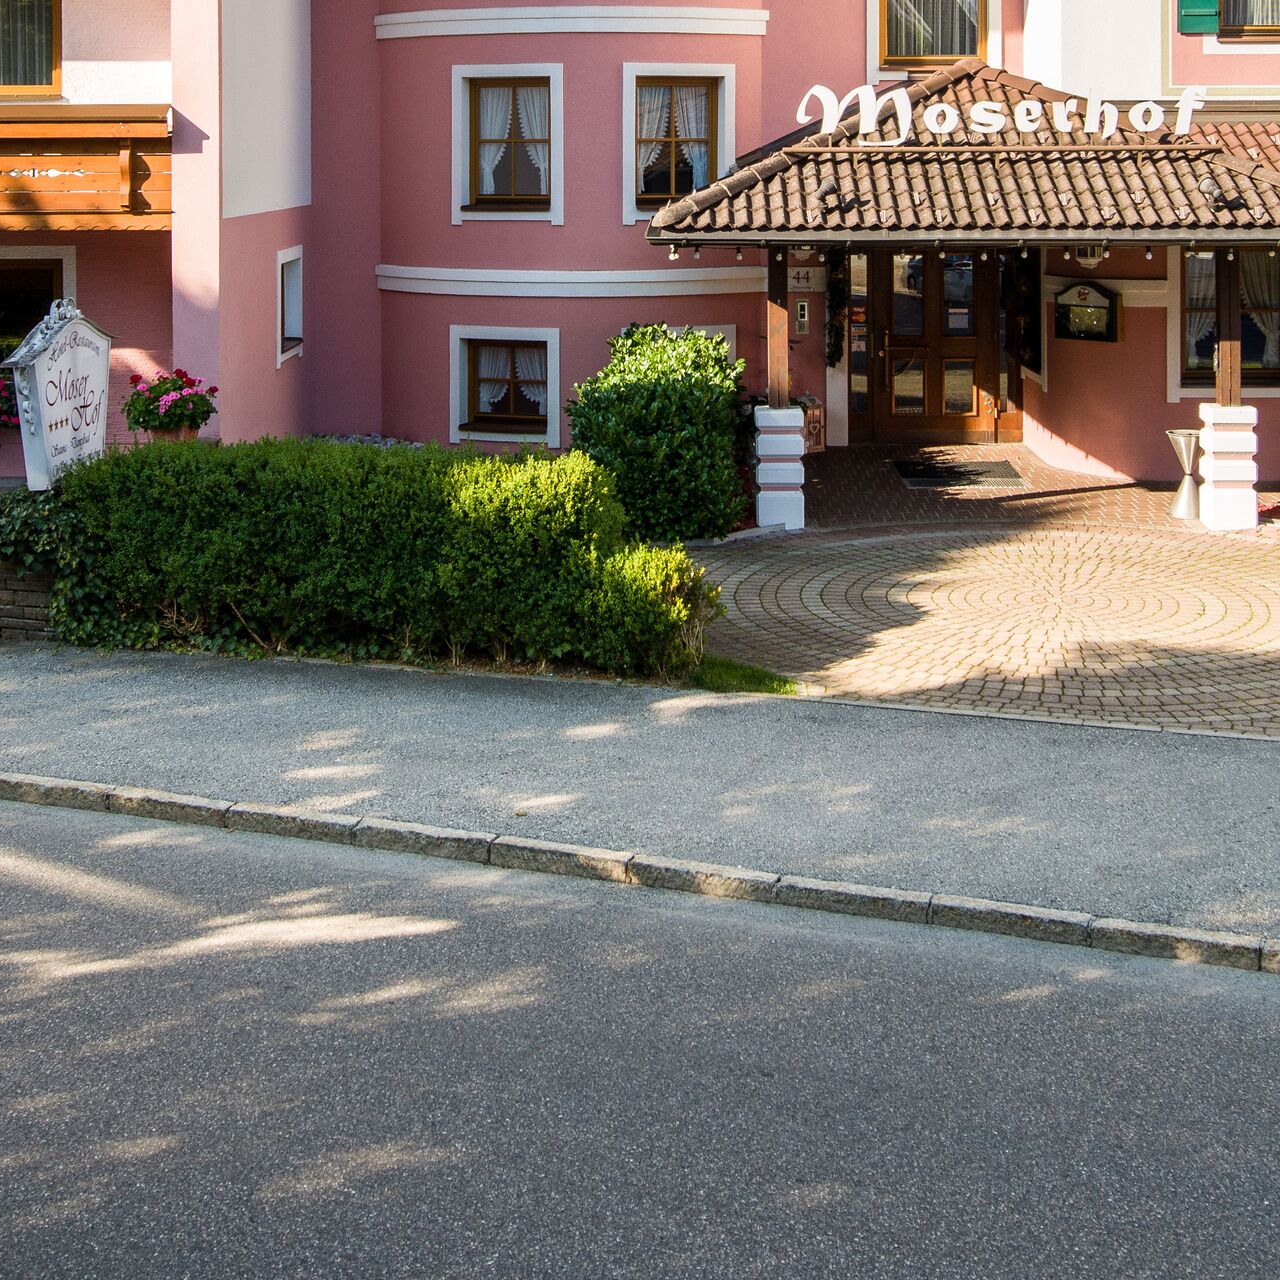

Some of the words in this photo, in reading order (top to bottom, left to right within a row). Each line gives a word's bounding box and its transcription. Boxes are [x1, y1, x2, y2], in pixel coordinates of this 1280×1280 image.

[795, 85, 1207, 146] Moserhof
[793, 271, 810, 284] 44
[45, 368, 89, 406] Moser
[71, 390, 104, 436] Hof
